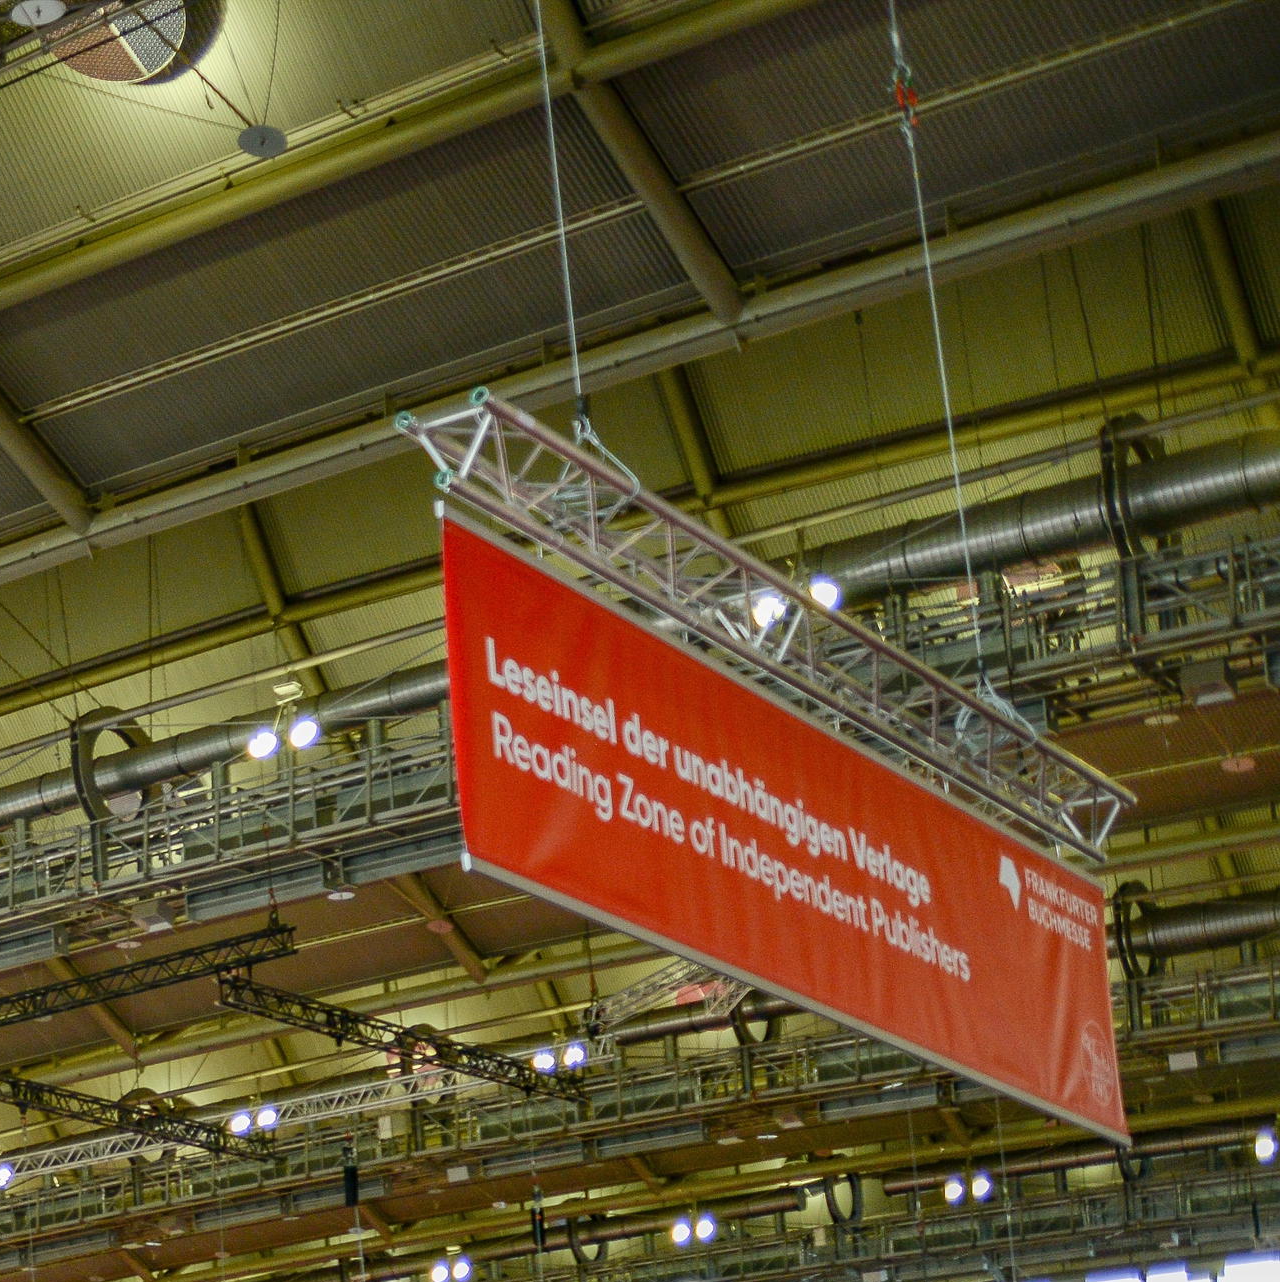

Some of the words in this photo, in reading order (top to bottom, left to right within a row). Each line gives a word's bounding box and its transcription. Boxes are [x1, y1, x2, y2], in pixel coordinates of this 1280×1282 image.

[486, 636, 617, 745] Leseinsel
[623, 712, 669, 768] der
[673, 745, 848, 861] unabhängigen
[849, 826, 932, 908] Verlage
[492, 710, 613, 822] Reading
[616, 772, 685, 844] Zone
[690, 817, 716, 858] of
[719, 822, 870, 932] Independent
[870, 897, 971, 982] Publishers
[1024, 866, 1098, 928] FRANKFURTER
[1027, 897, 1092, 952] BUCHMESSE
